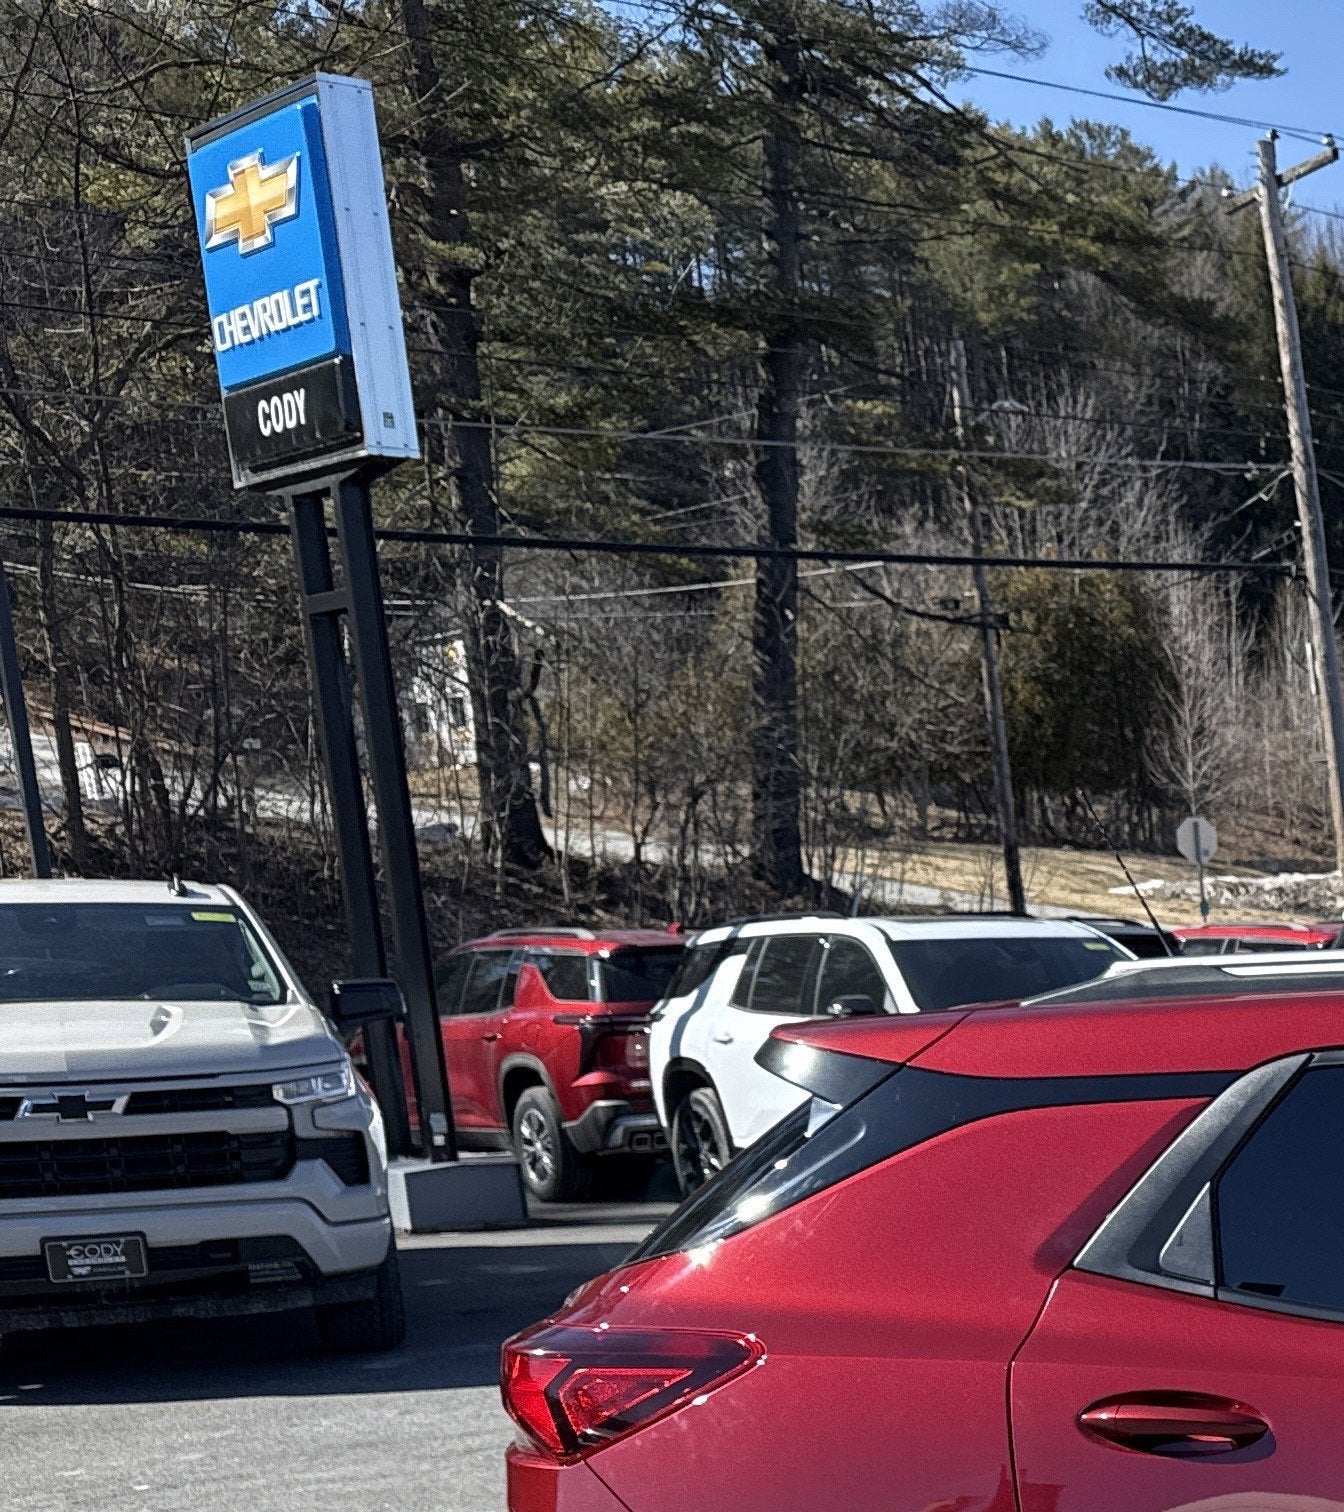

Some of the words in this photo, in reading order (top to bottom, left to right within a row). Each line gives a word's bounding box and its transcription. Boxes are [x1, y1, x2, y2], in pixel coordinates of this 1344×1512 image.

[213, 278, 322, 352] CHEVROLET
[257, 388, 307, 437] CODY
[68, 1242, 124, 1260] CODY
